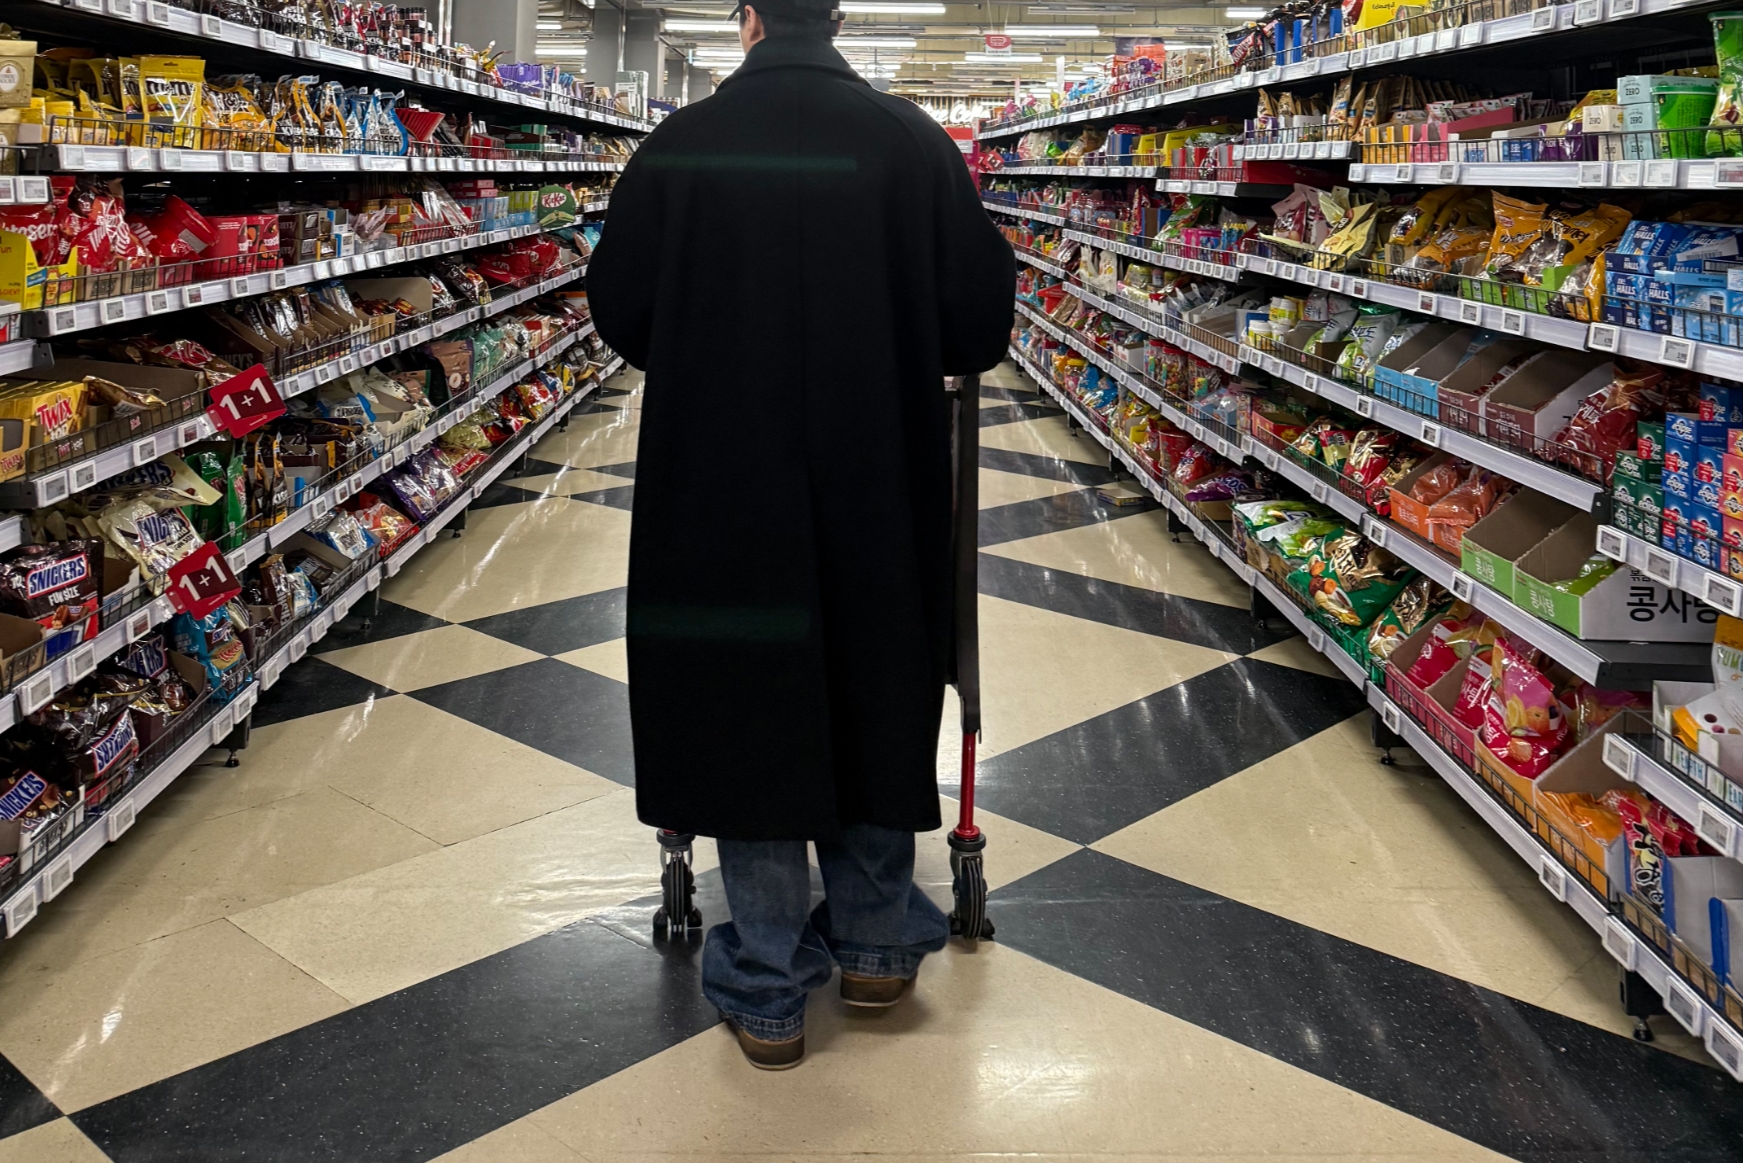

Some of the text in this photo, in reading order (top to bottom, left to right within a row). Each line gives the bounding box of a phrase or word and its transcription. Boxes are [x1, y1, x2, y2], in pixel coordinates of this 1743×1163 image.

[1625, 87, 1640, 97] ZERO
[1589, 117, 1601, 125] ZERO
[1630, 115, 1643, 125] ZERO
[1634, 230, 1655, 241] HALLS
[1624, 261, 1639, 271] HALLS
[1673, 266, 1700, 274] HALLS
[1616, 284, 1637, 295] HALLS
[1648, 288, 1670, 300] HALLS
[219, 377, 272, 420] 1+1
[28, 554, 86, 595] SNICKERS
[178, 554, 229, 602] 1+1
[49, 586, 80, 607] FUN SIZE
